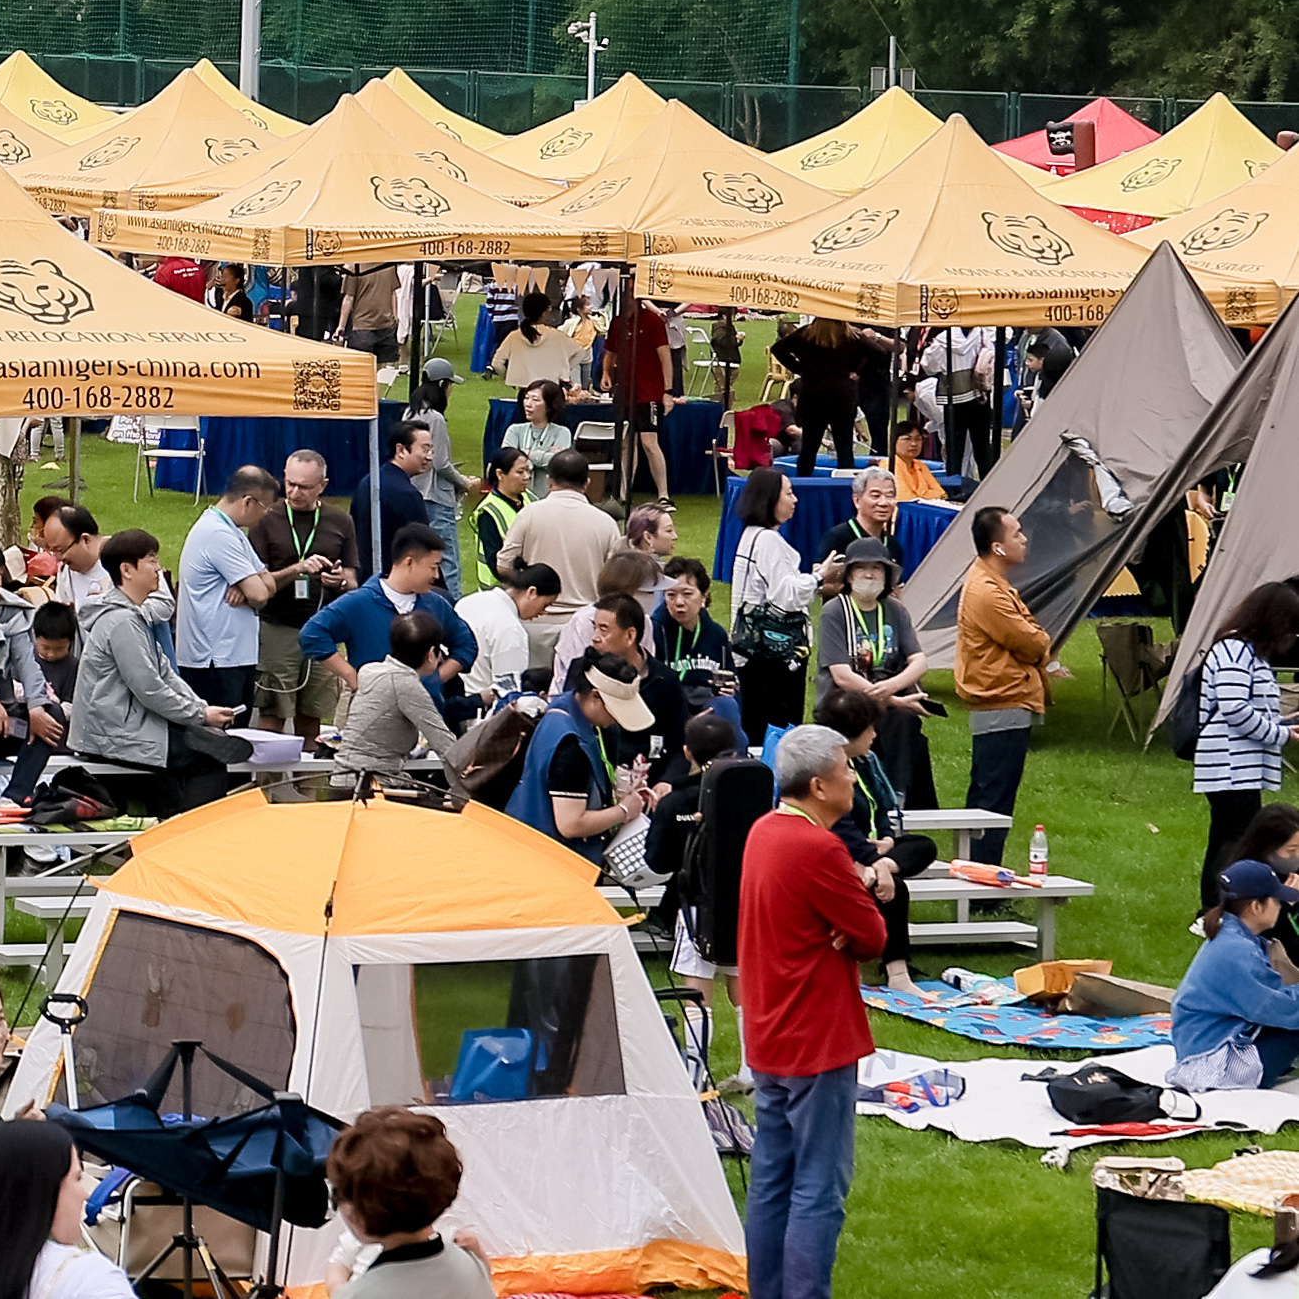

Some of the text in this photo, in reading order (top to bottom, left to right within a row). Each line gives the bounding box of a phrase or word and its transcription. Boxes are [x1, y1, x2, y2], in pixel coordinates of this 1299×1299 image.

[157, 235, 211, 255] 400-168-2882
[419, 240, 511, 257] 400-168-2882
[729, 286, 800, 309] 400-168-2882
[6, 330, 145, 343] RELOCATION
[149, 331, 247, 343] SERVICES
[22, 385, 175, 410] 400-168-2882
